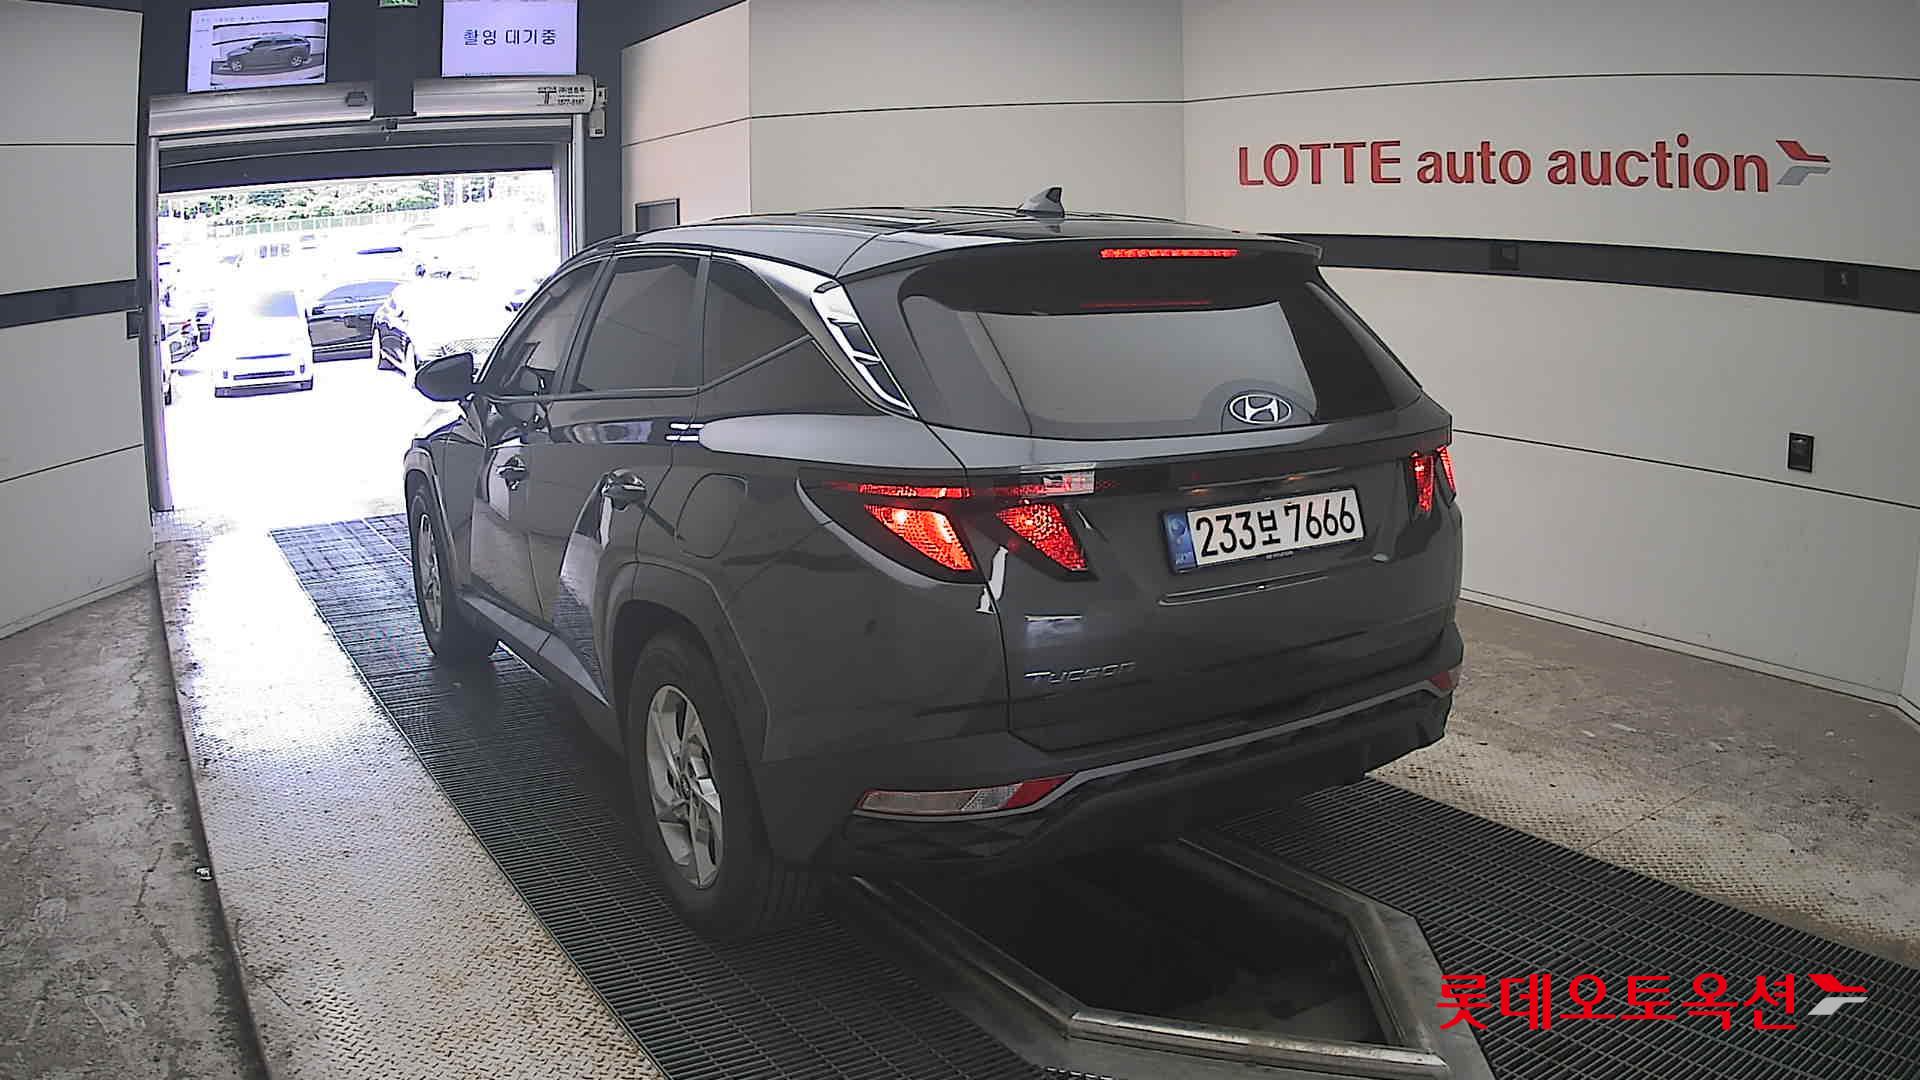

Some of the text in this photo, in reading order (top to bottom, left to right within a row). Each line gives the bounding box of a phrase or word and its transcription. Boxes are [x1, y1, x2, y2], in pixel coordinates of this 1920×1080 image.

[463, 29, 557, 46] 촬영 대기중
[1238, 132, 1770, 193] LOTTE auto auction
